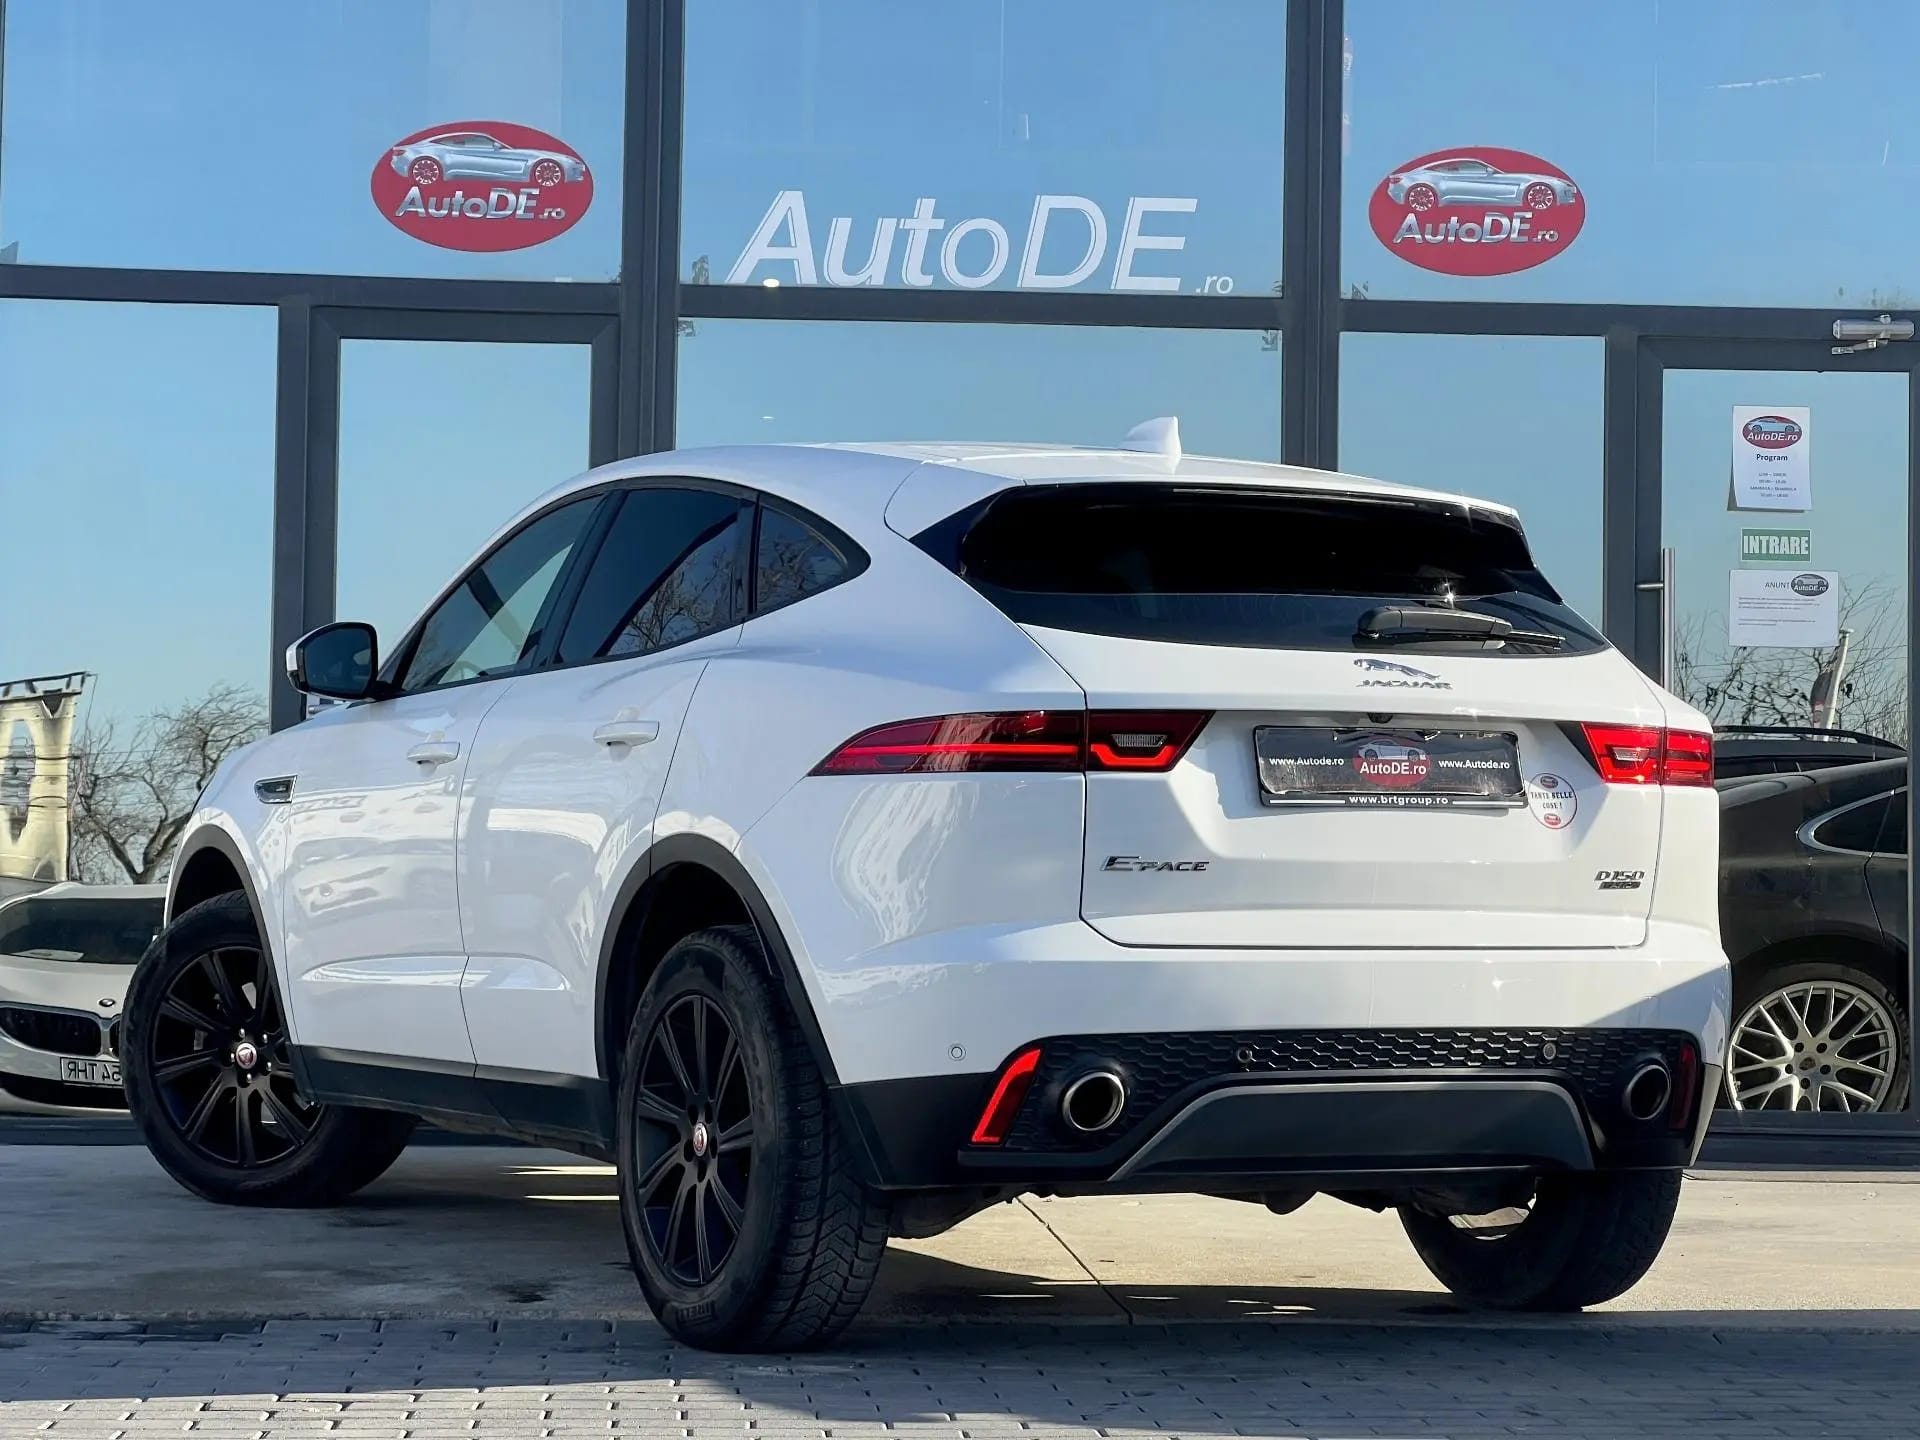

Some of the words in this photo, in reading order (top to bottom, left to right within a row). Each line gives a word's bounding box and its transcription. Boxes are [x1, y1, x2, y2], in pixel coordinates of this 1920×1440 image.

[1746, 432, 1799, 441] AutoDE.ro
[1756, 453, 1789, 462] Program
[1743, 535, 1809, 555] INTRARE
[1356, 679, 1453, 690] JAGUAR
[1268, 756, 1345, 767] www.Autode.ro
[1438, 759, 1510, 770] www.Autode.ro
[1359, 761, 1427, 776] AutoDE.ro
[1348, 794, 1449, 806] www.brtgroup.ro
[1551, 791, 1573, 799] BELLE
[1593, 870, 1645, 881] D150
